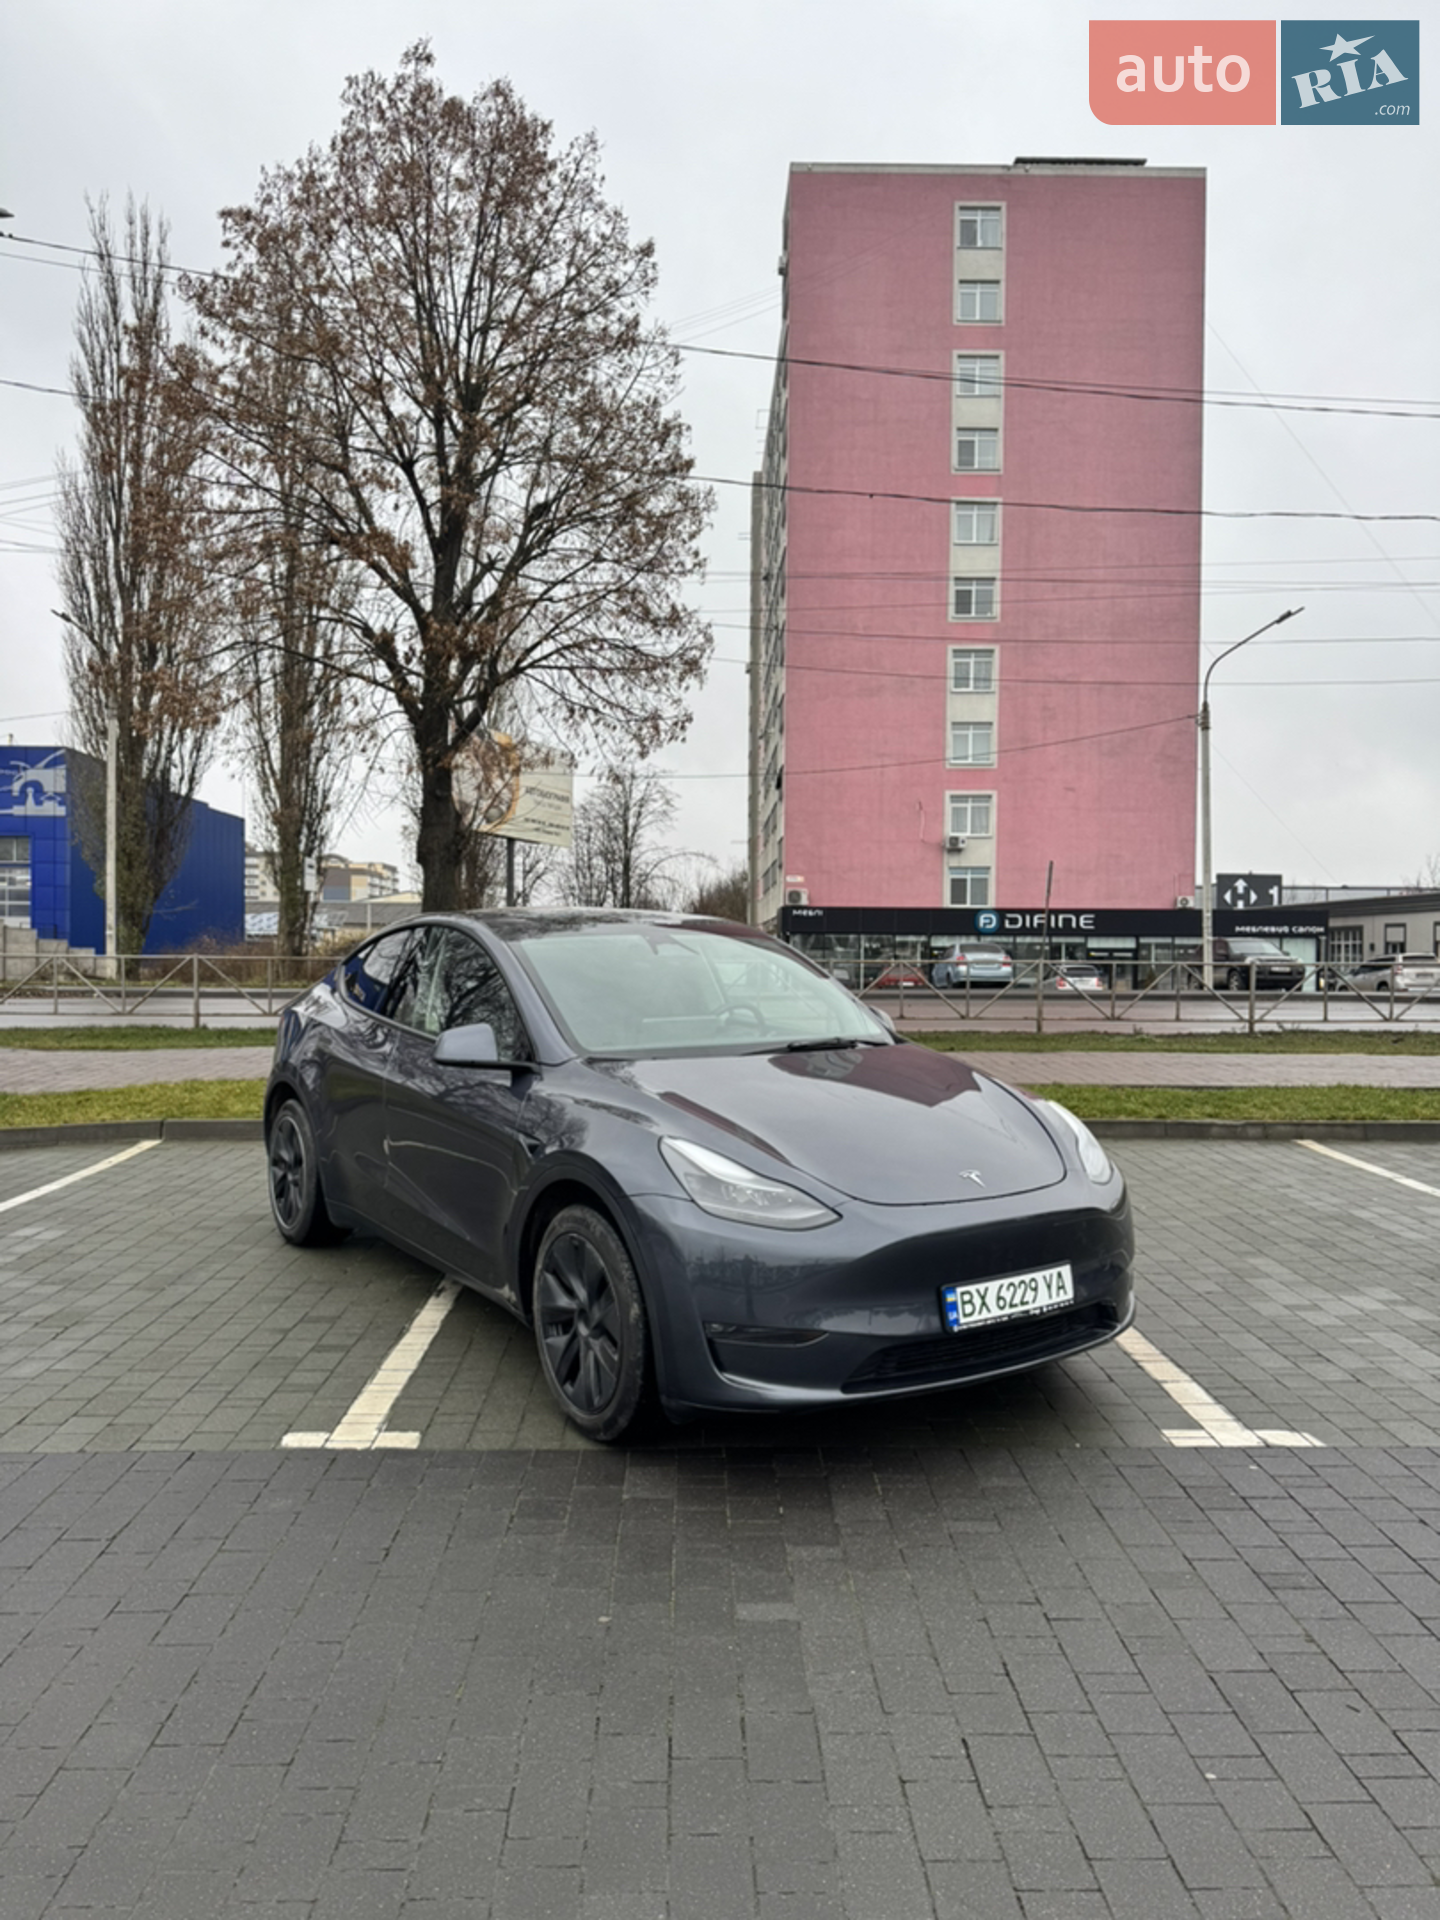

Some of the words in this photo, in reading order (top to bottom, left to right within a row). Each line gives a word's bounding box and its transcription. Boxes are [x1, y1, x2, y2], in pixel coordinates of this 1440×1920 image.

[1004, 913, 1096, 930] DIFINE
[959, 1286, 991, 1319] BX
[995, 1276, 1039, 1311] 6229
[1042, 1269, 1068, 1301] YA
